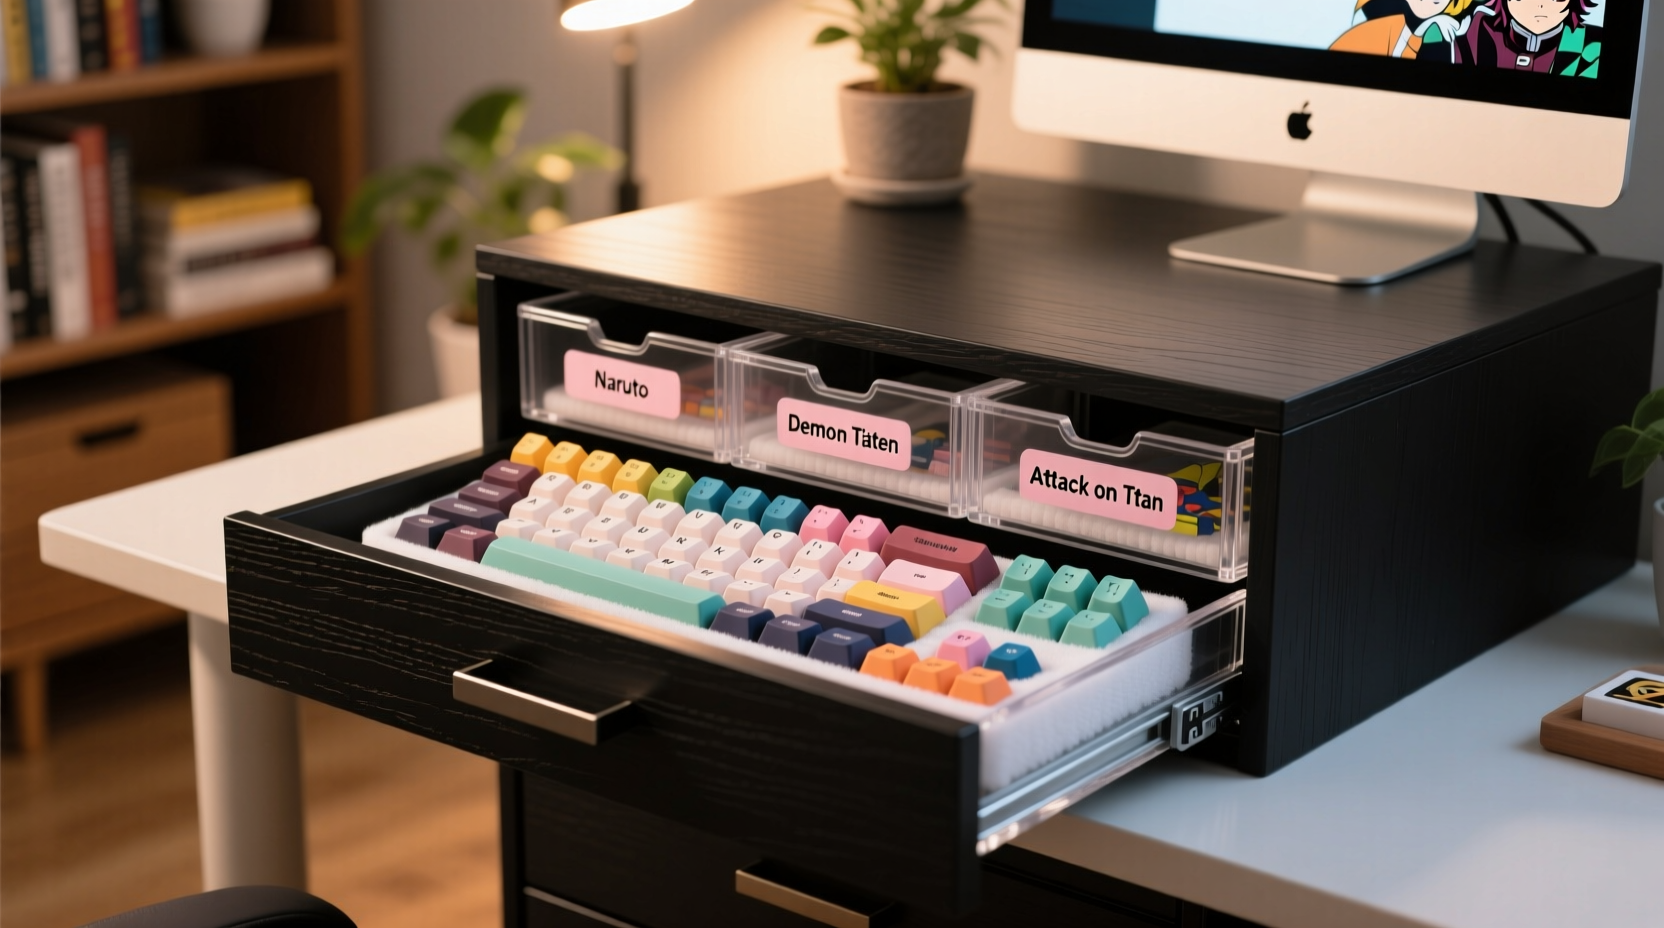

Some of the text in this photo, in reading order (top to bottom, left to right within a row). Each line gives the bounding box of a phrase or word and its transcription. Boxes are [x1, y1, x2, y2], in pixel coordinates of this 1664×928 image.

[594, 369, 649, 399] Naruto
[788, 413, 847, 443] Demon
[1029, 465, 1090, 497] Attack
[1094, 484, 1118, 503] on
